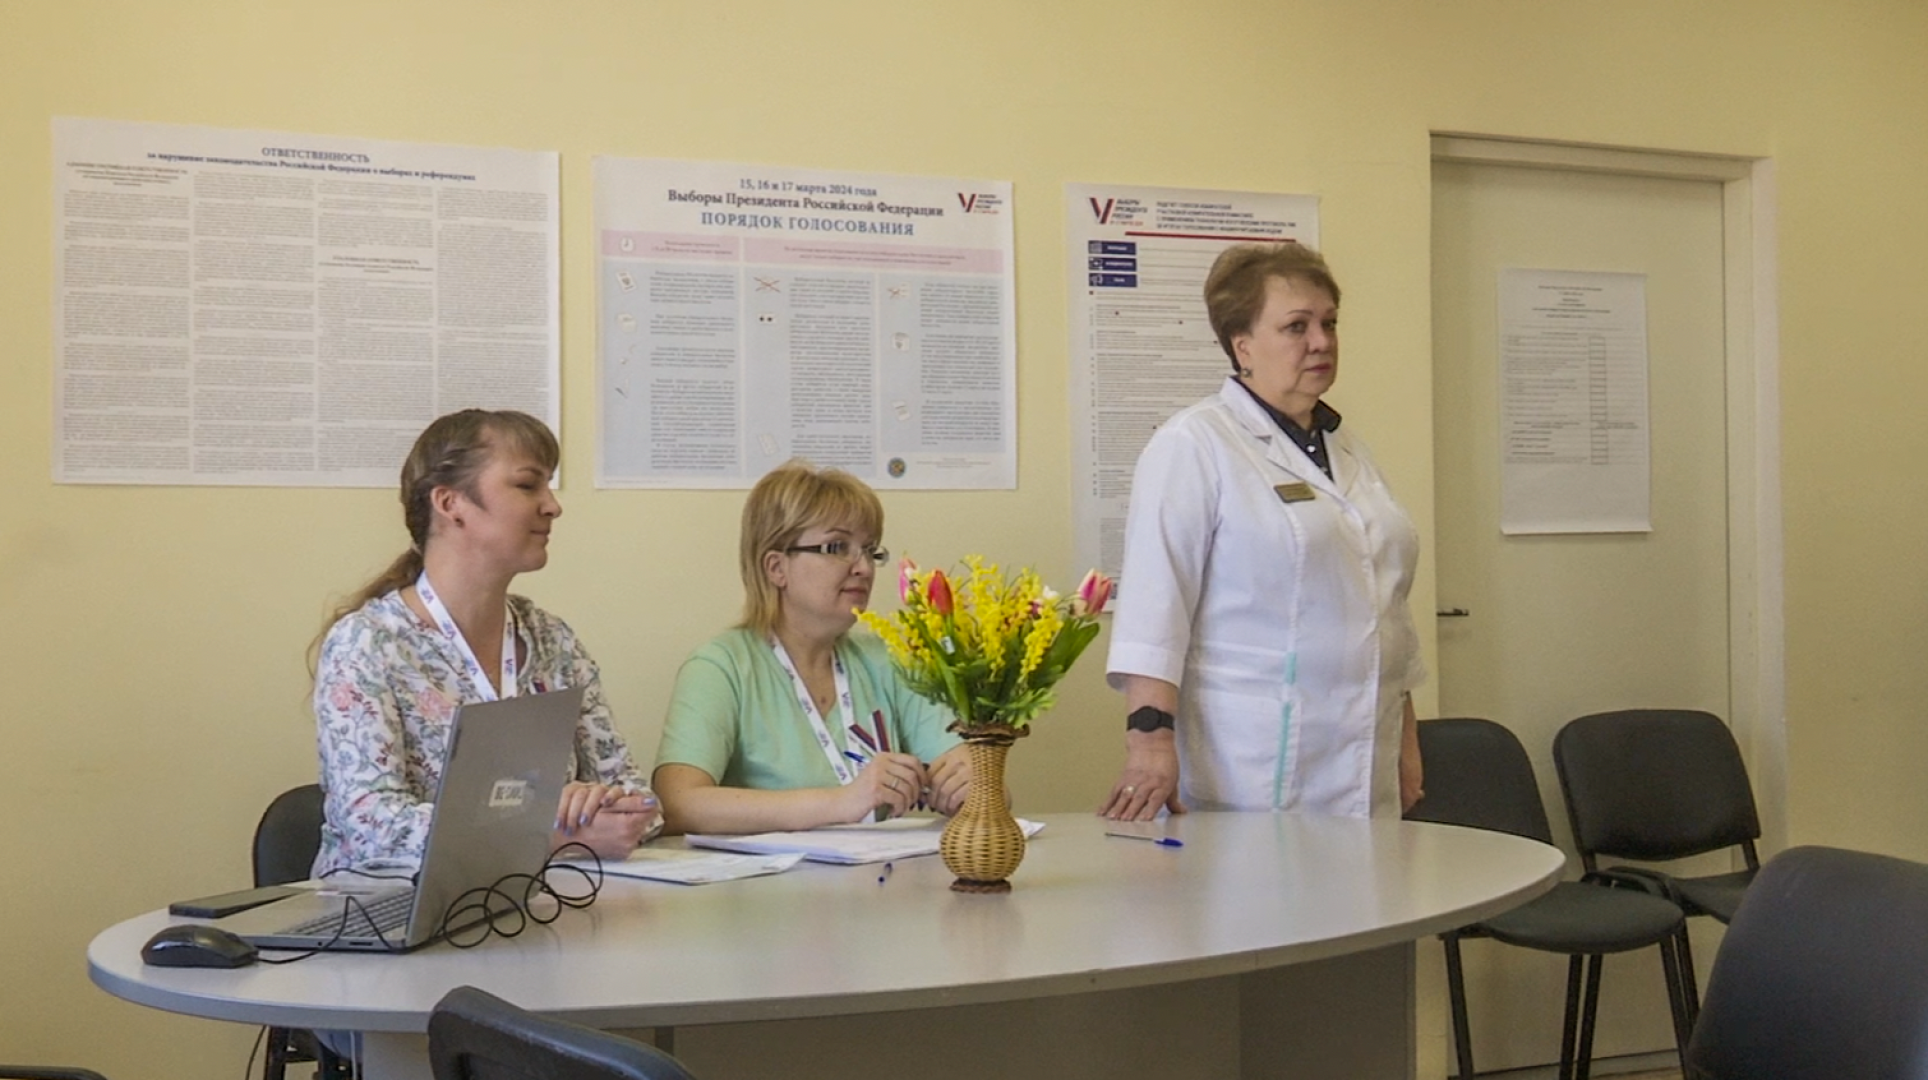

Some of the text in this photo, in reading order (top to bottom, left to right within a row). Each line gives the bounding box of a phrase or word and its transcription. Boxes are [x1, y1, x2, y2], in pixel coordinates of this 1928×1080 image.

[262, 147, 370, 163] ОТВЕТСТВЕННОСТЬ
[280, 160, 326, 171] Российской
[327, 163, 371, 175] Федерации
[740, 178, 877, 197] 15, 16 и 17 марта 2024 года
[668, 189, 944, 218] Выборы Президента Российской Федерации
[701, 211, 914, 236] ПОРЯДОК ГОЛОСОВАНИЯ
